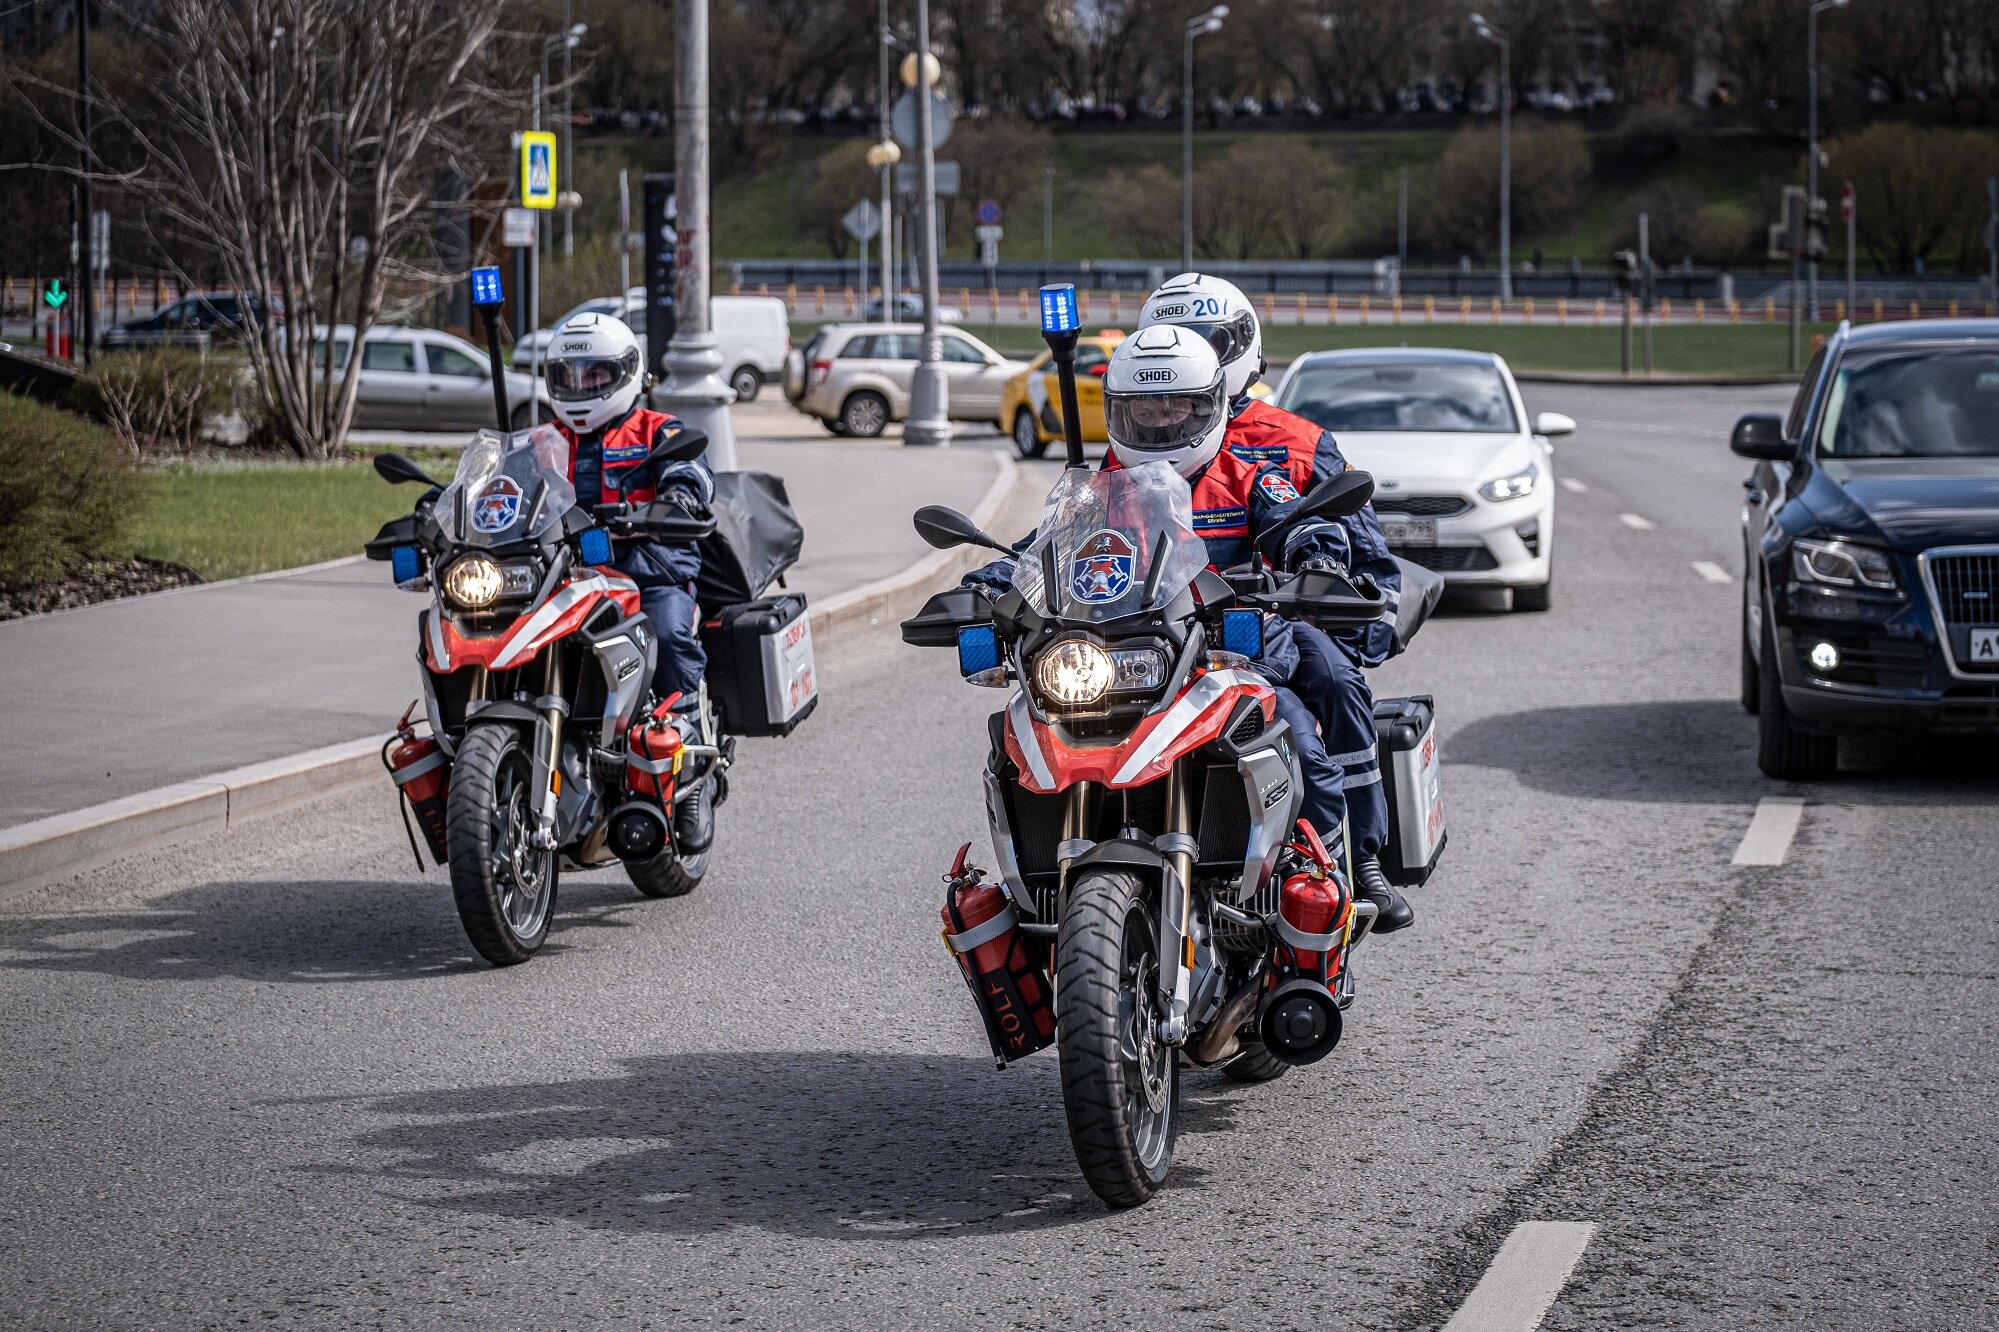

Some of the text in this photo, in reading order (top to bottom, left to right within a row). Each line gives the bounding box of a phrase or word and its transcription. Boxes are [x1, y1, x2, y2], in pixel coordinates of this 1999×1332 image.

[1155, 306, 1184, 319] SHOEI
[564, 343, 588, 351] SHOEI
[1138, 370, 1172, 382] SHOEI
[986, 982, 1026, 1050] ROLF
